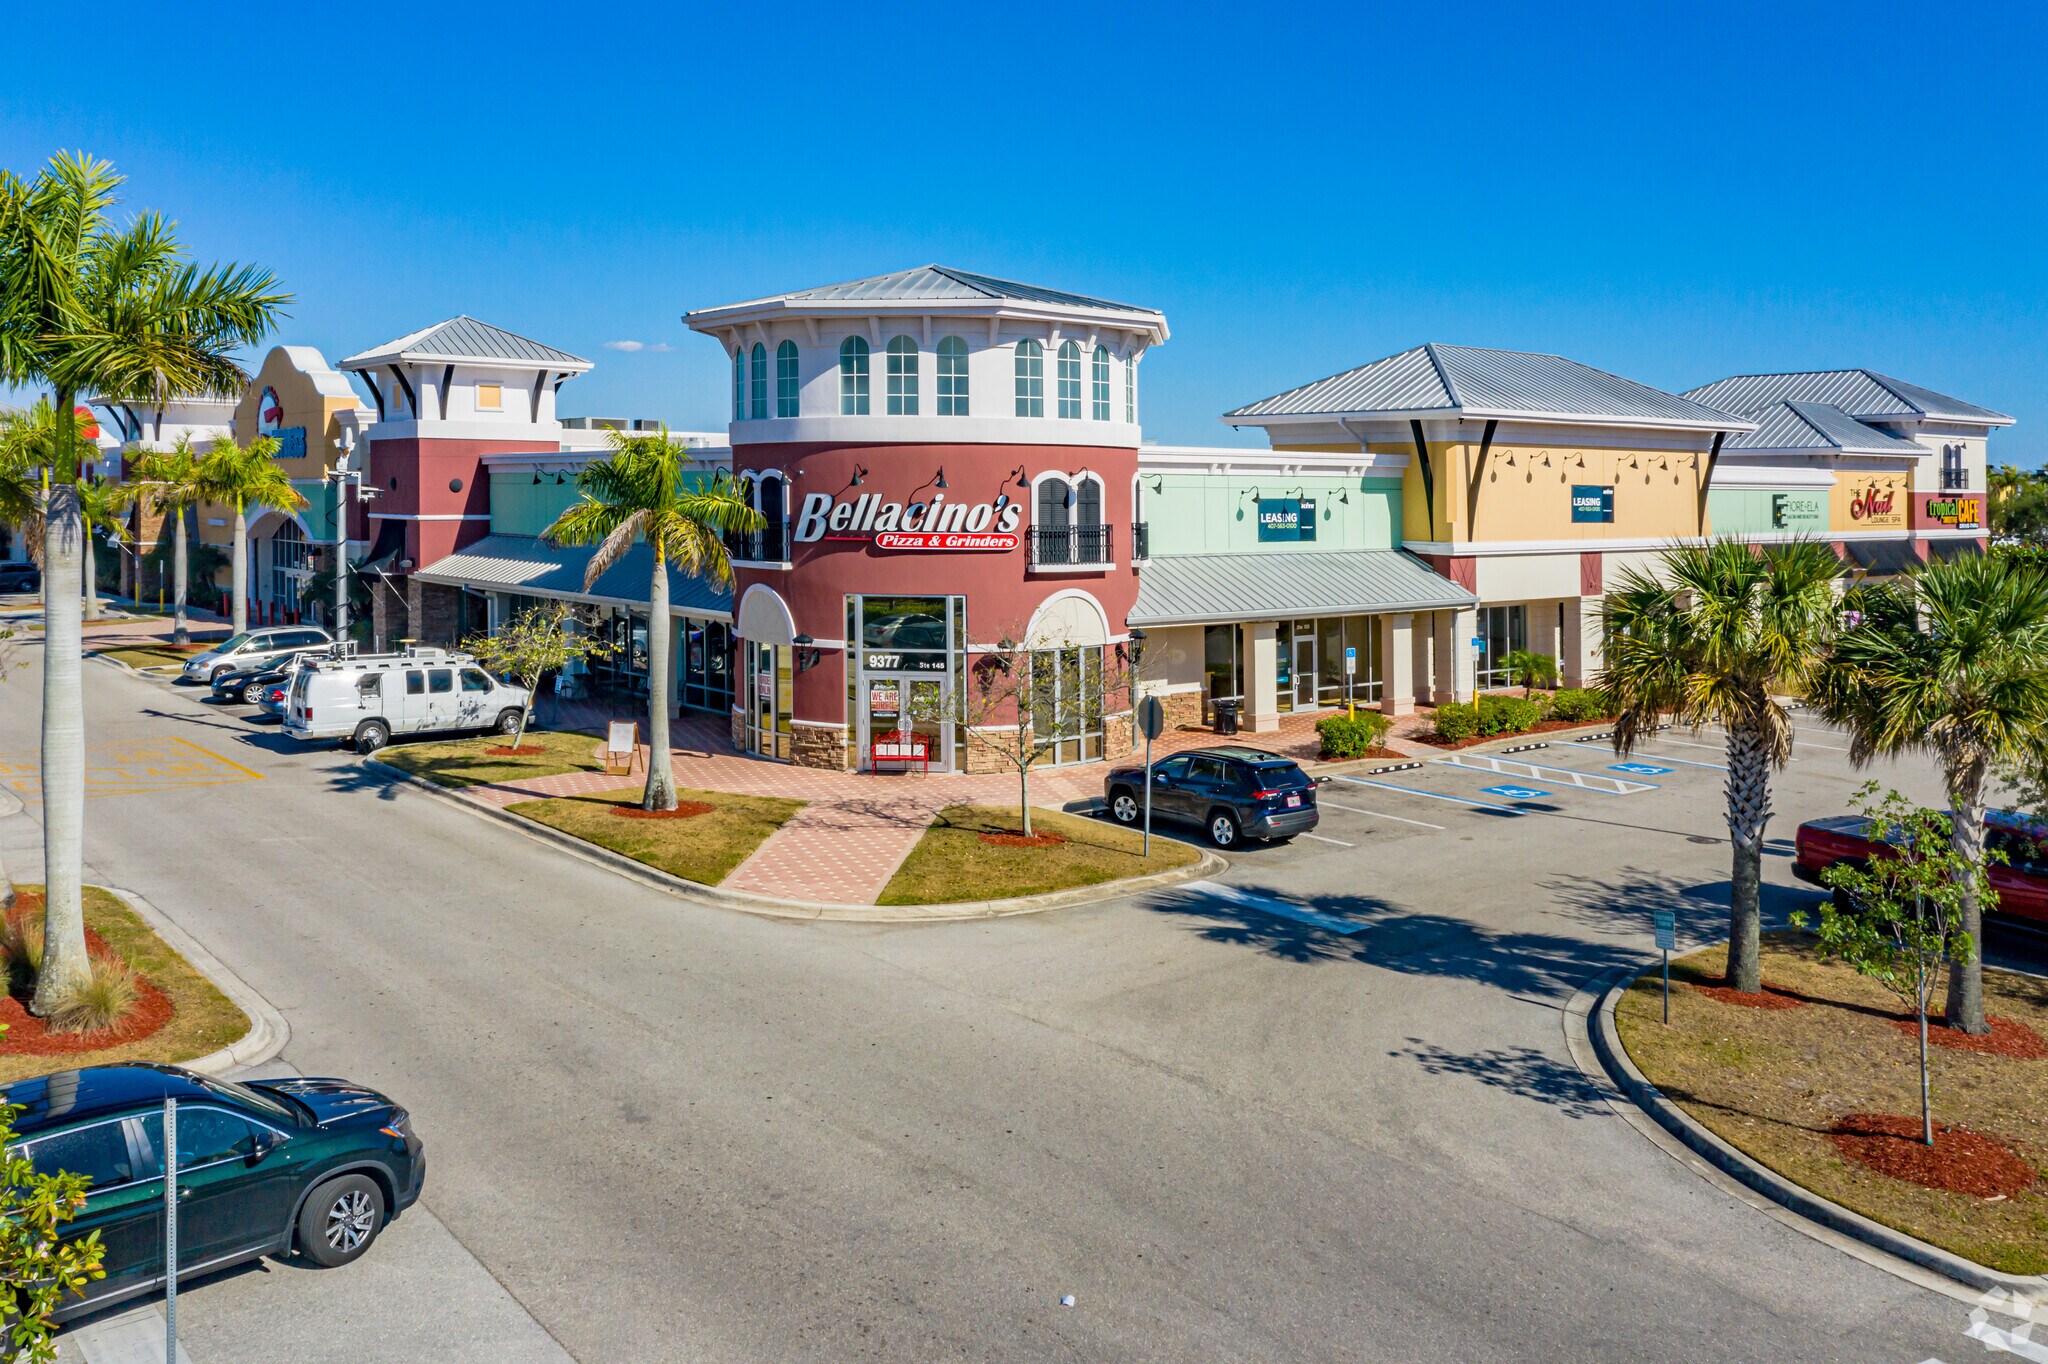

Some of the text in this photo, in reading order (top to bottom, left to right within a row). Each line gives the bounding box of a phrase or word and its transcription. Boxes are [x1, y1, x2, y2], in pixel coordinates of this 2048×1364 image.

[1850, 489, 1861, 497] THE
[1573, 498, 1601, 506] LEASING
[1850, 488, 1895, 520] Nail
[1929, 498, 1958, 519] tropical
[1958, 499, 1979, 523] CAFE
[794, 493, 1023, 543] Bellacino's
[1261, 513, 1297, 523] LEASING
[882, 535, 1015, 547] Pizza & Grinders
[869, 655, 900, 668] 9377
[871, 691, 898, 701] WE ARE
